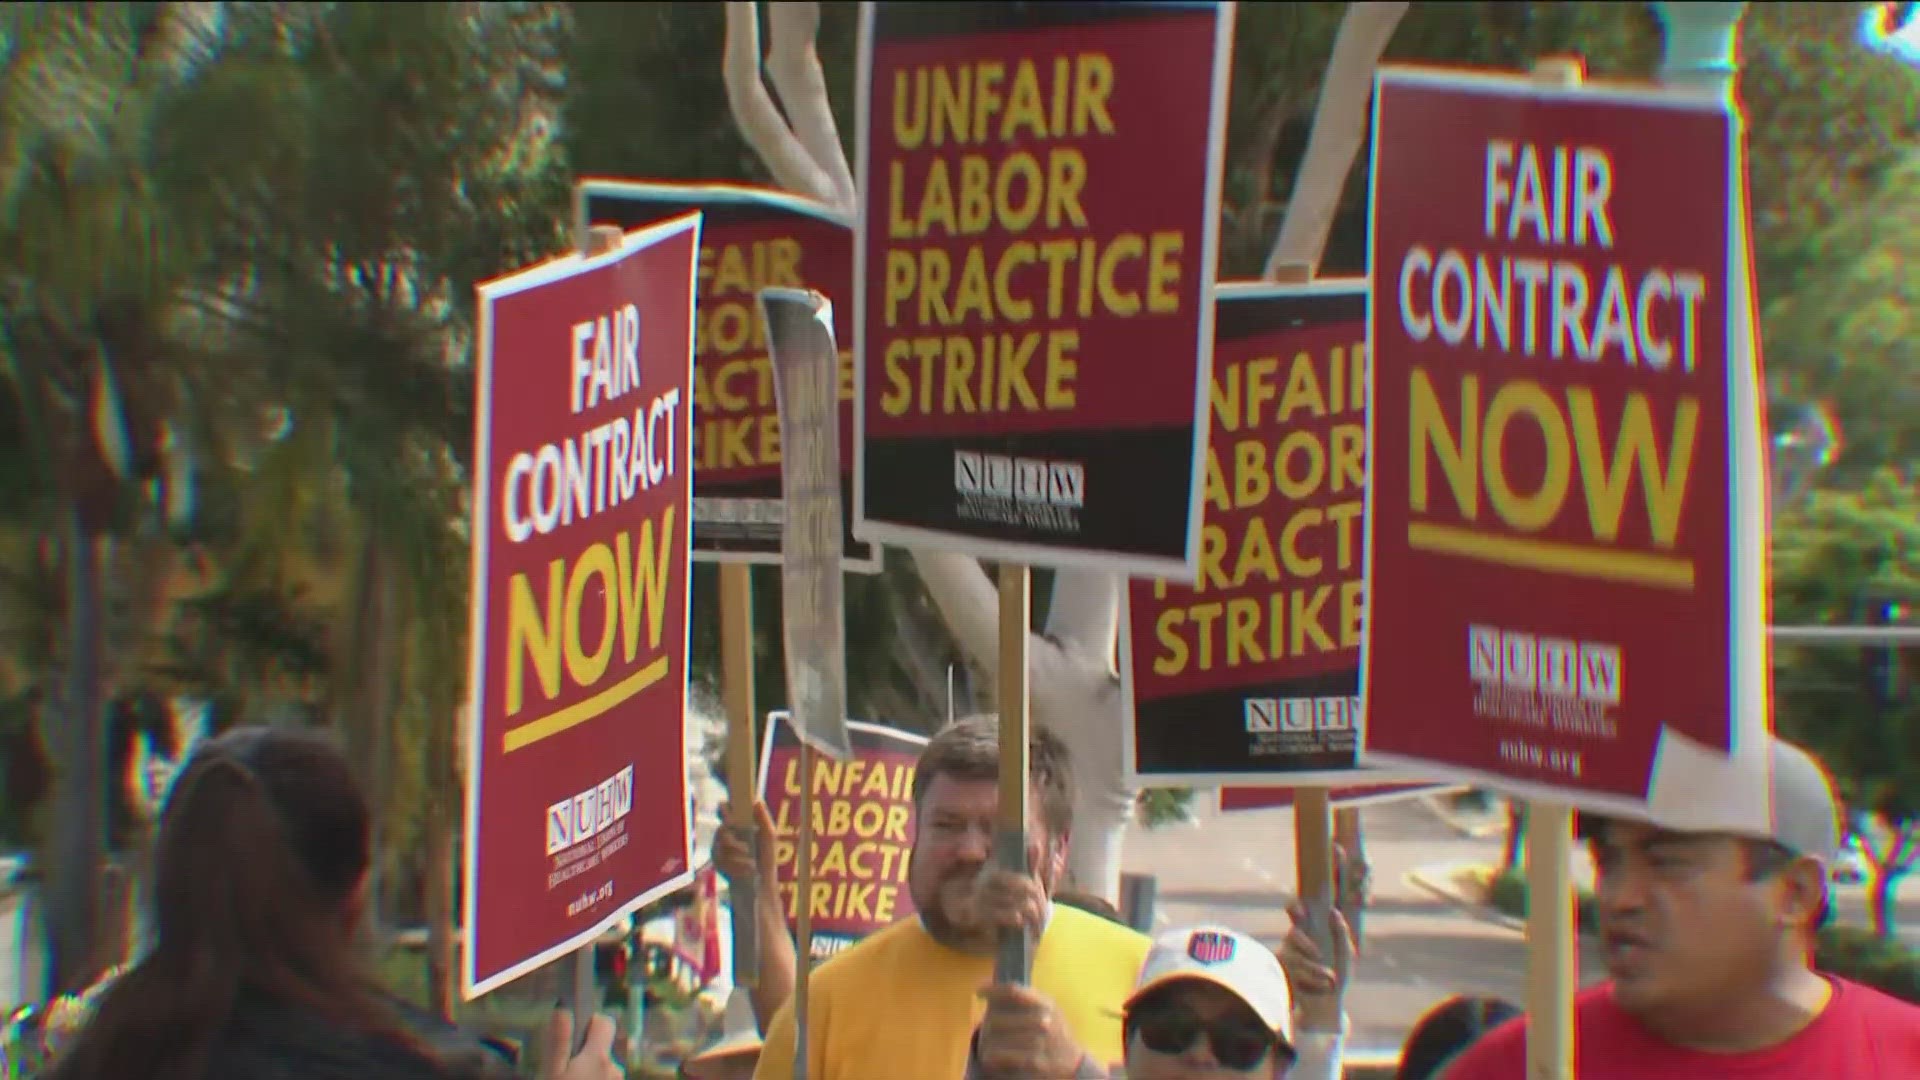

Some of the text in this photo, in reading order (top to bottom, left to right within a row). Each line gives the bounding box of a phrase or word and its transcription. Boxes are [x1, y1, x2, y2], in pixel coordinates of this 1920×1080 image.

[893, 53, 1116, 149] UNFAIR
[888, 147, 1089, 239] LABOR
[1484, 140, 1616, 249] FAIR
[699, 236, 803, 296] FAIR
[884, 231, 1185, 328] PRACTICE
[1400, 246, 1706, 374] CONTRACT
[570, 303, 641, 414] FAIR
[880, 329, 1081, 417] STRIKE
[1211, 341, 1366, 432] NFAI
[503, 387, 680, 543] CONTRACT
[954, 452, 1083, 506] NUHW
[1204, 423, 1366, 511] ABOR
[1409, 366, 1699, 549] NOW
[506, 503, 675, 718] NOW
[1153, 578, 1363, 677] STRIKE
[1470, 626, 1620, 702] NUHW
[1246, 698, 1360, 731] NUH
[547, 766, 633, 853] NUHW
[567, 879, 613, 917] nuhw.org
[779, 880, 898, 923] TRIKE
